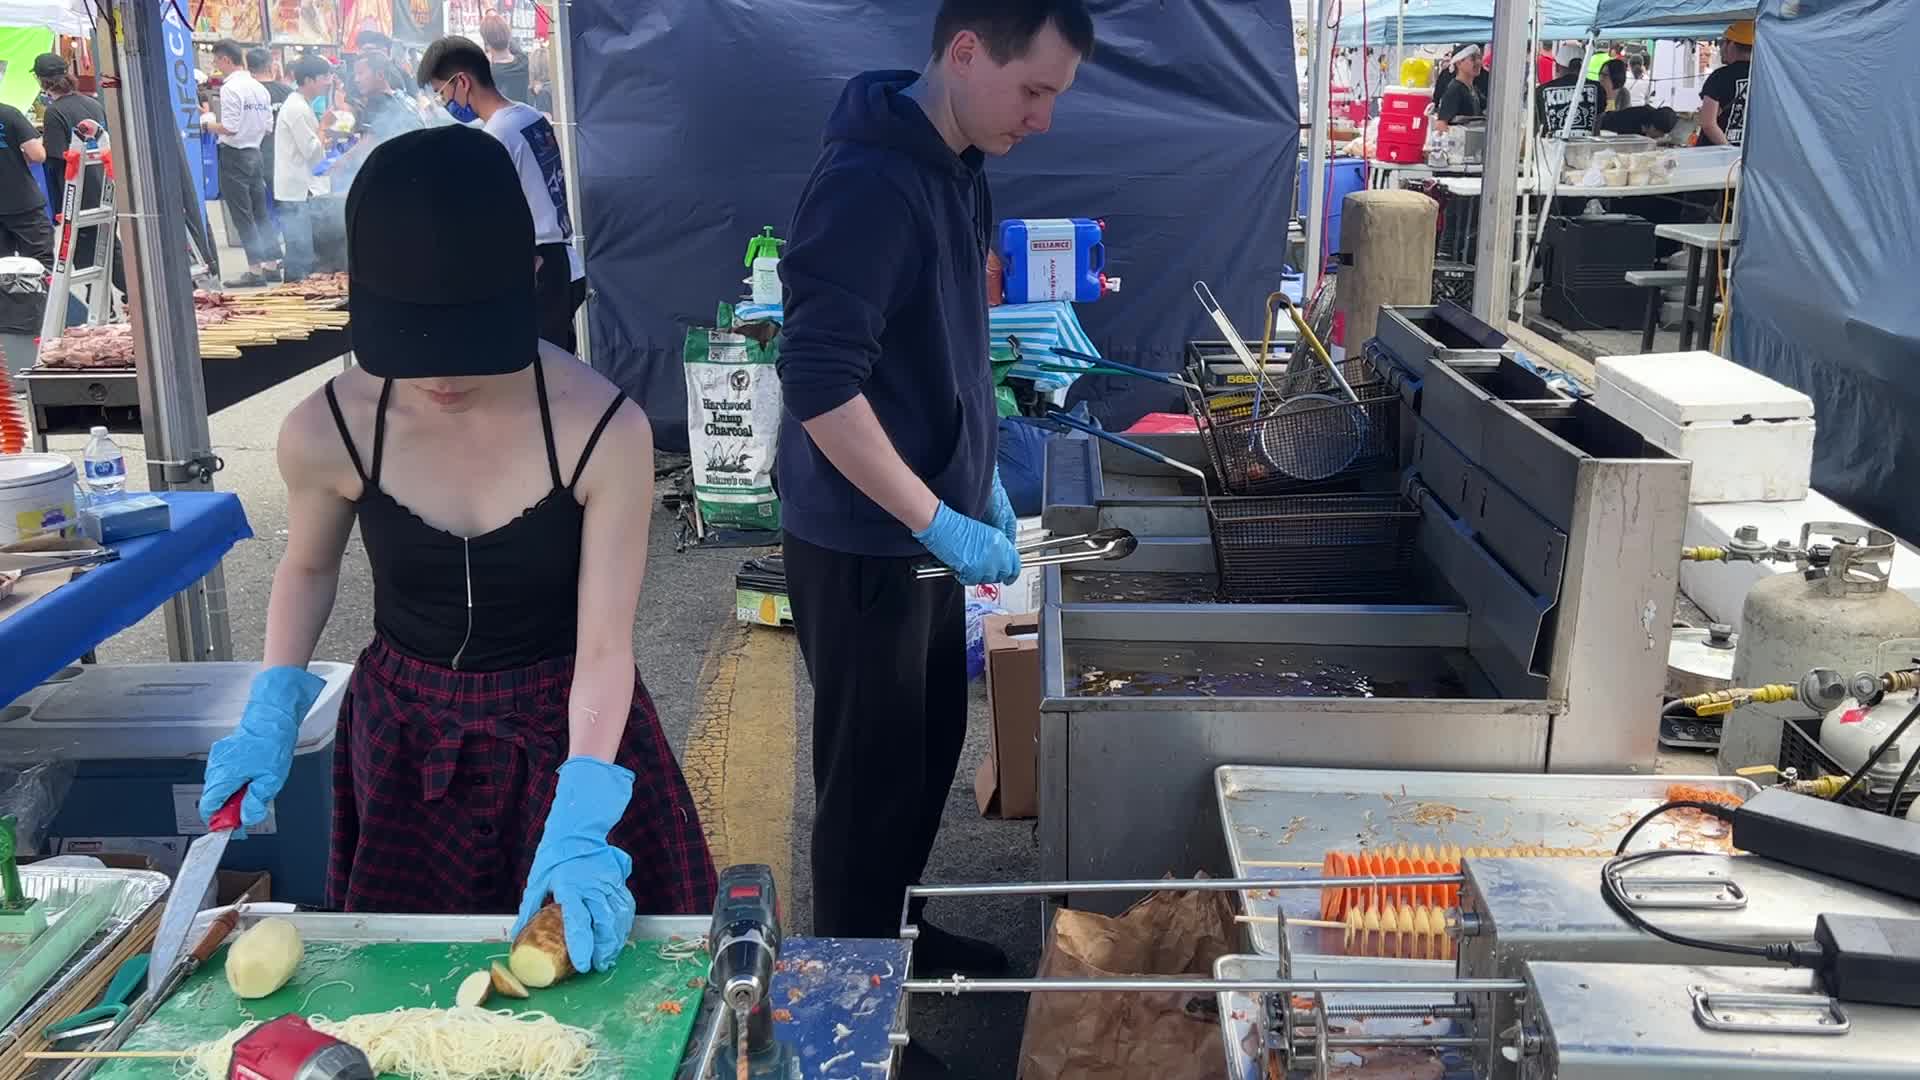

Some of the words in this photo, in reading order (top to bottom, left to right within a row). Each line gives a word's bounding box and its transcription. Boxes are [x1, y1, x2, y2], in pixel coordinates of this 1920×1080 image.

[1033, 241, 1069, 249] RELIANCE
[702, 398, 752, 411] Hardwood
[712, 411, 743, 426] Lump
[704, 423, 754, 437] Charcoal
